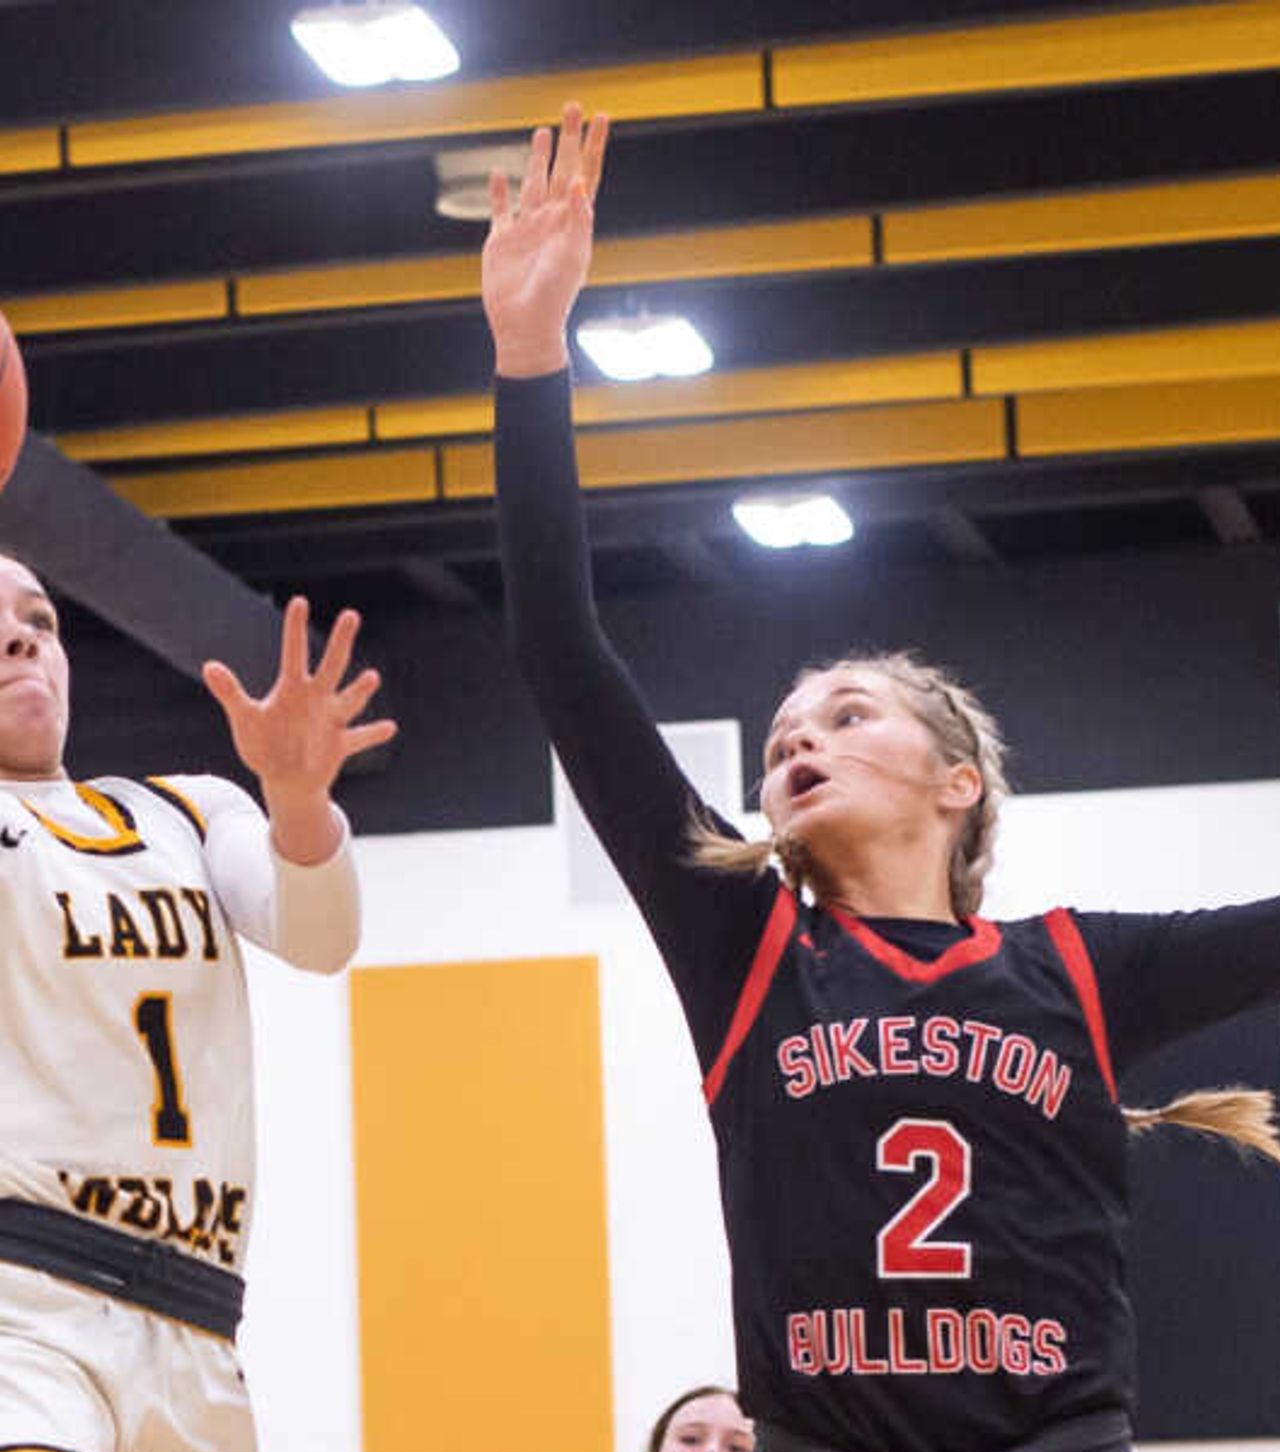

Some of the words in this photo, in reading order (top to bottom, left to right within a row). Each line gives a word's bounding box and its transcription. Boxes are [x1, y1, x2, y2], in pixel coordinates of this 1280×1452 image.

[55, 886, 219, 960] LADY
[132, 989, 193, 1149] 1
[777, 1016, 1071, 1119] SIKESTON
[876, 1117, 972, 1280] 2
[787, 1308, 1068, 1376] BULLDOGS
